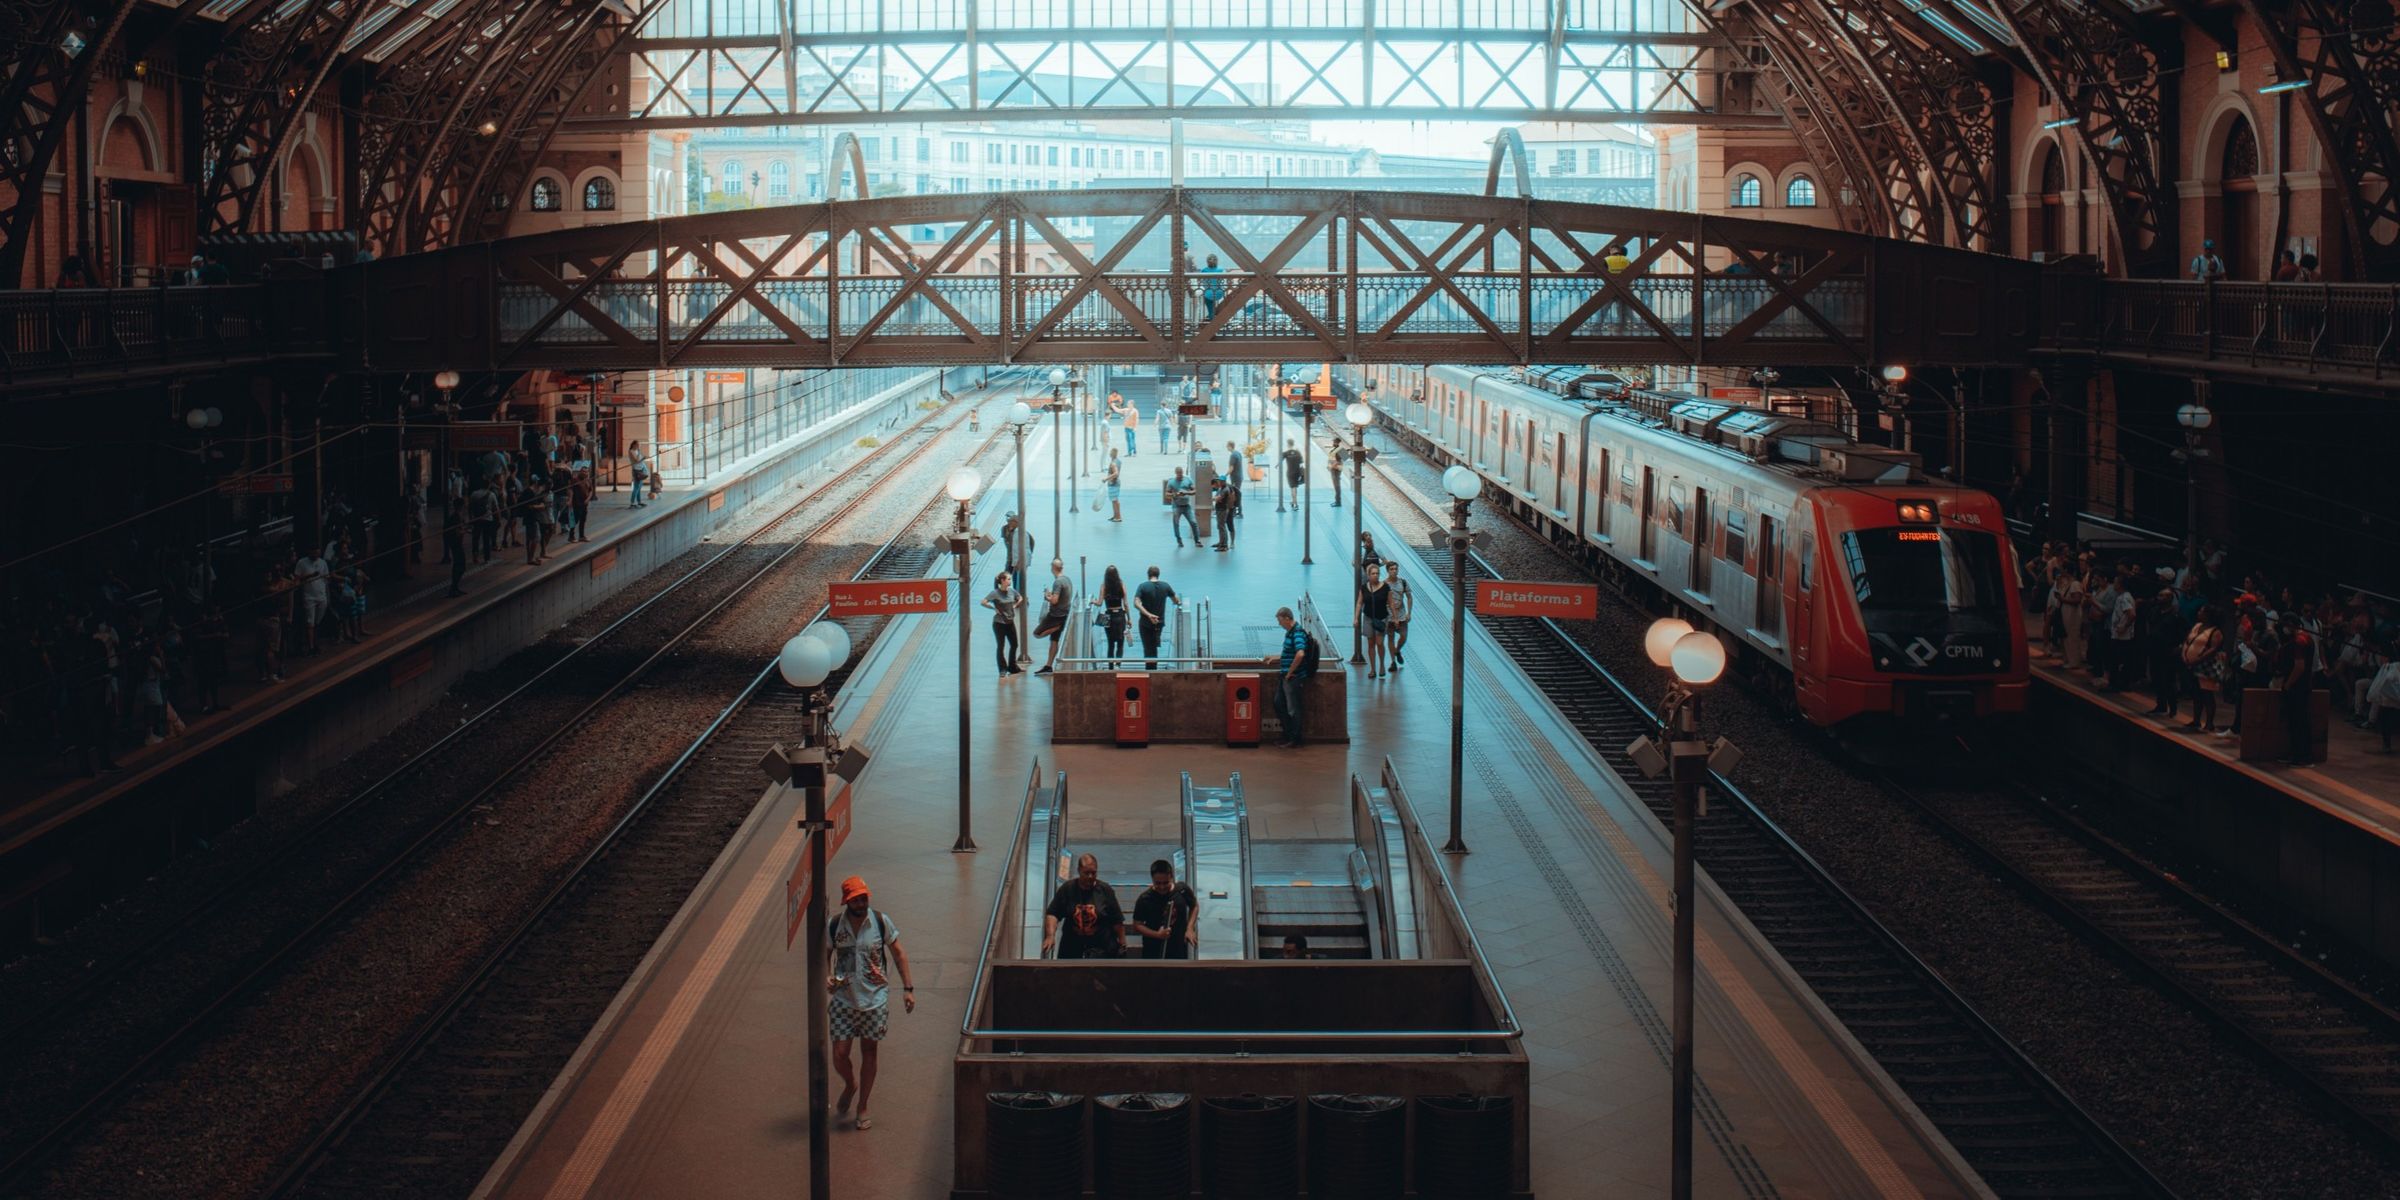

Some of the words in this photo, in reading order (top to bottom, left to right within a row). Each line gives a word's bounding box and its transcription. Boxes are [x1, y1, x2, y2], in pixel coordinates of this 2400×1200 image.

[880, 592, 924, 606] Saída
[1490, 590, 1570, 605] Plataforma
[1574, 595, 1582, 605] 3
[1945, 645, 1983, 658] CPTM
